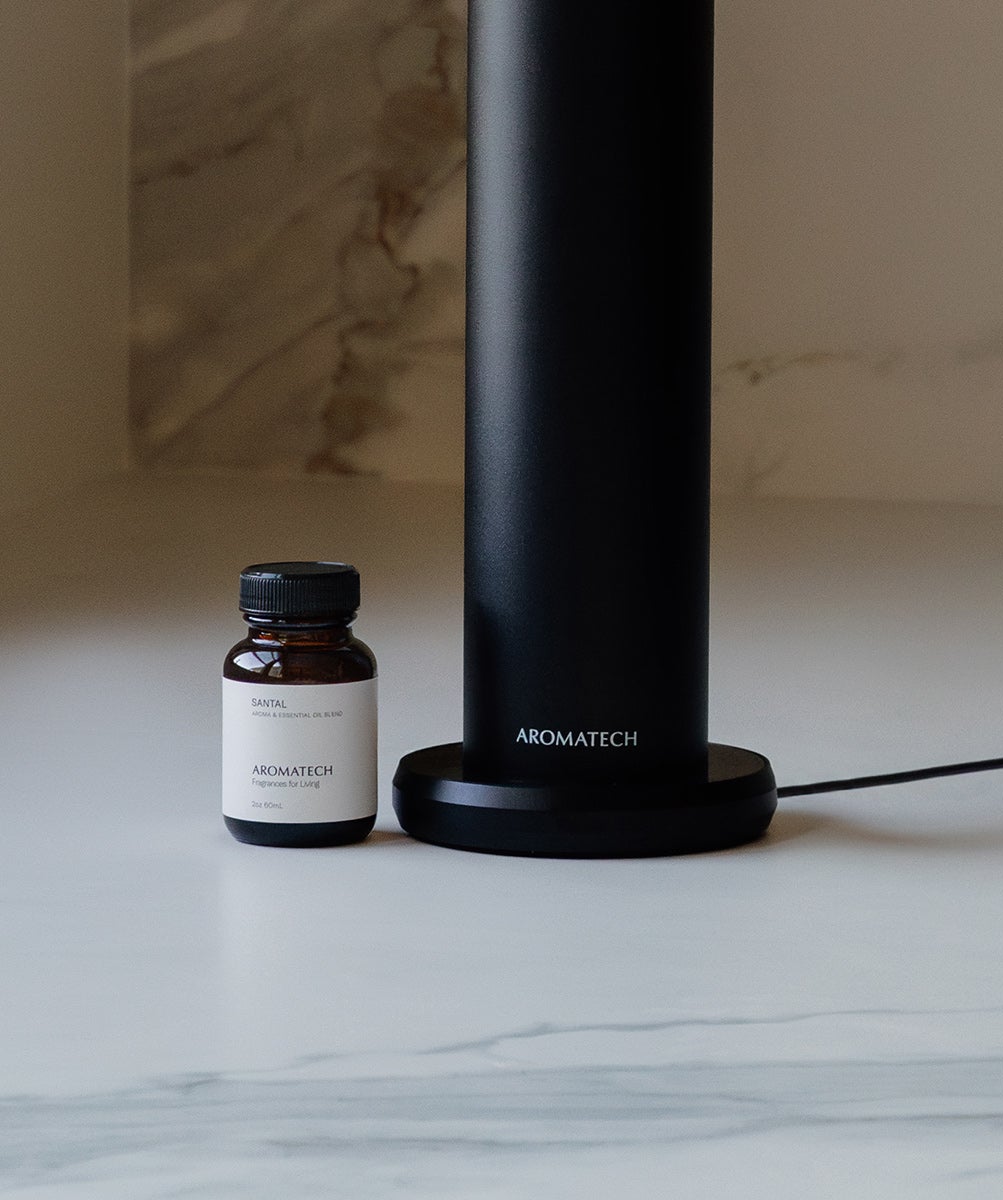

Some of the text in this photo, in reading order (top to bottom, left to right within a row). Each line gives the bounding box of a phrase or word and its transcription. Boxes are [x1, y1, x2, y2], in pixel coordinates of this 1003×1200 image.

[251, 698, 287, 708] SANTAL
[252, 710, 271, 718] AROMA
[272, 710, 277, 718] &
[278, 711, 311, 719] ESSENTIAL
[323, 710, 343, 718] BLEND
[516, 727, 637, 747] AROMATECH
[252, 765, 333, 776] AROMATECH
[252, 778, 287, 788] Fragrances
[300, 780, 320, 789] Living
